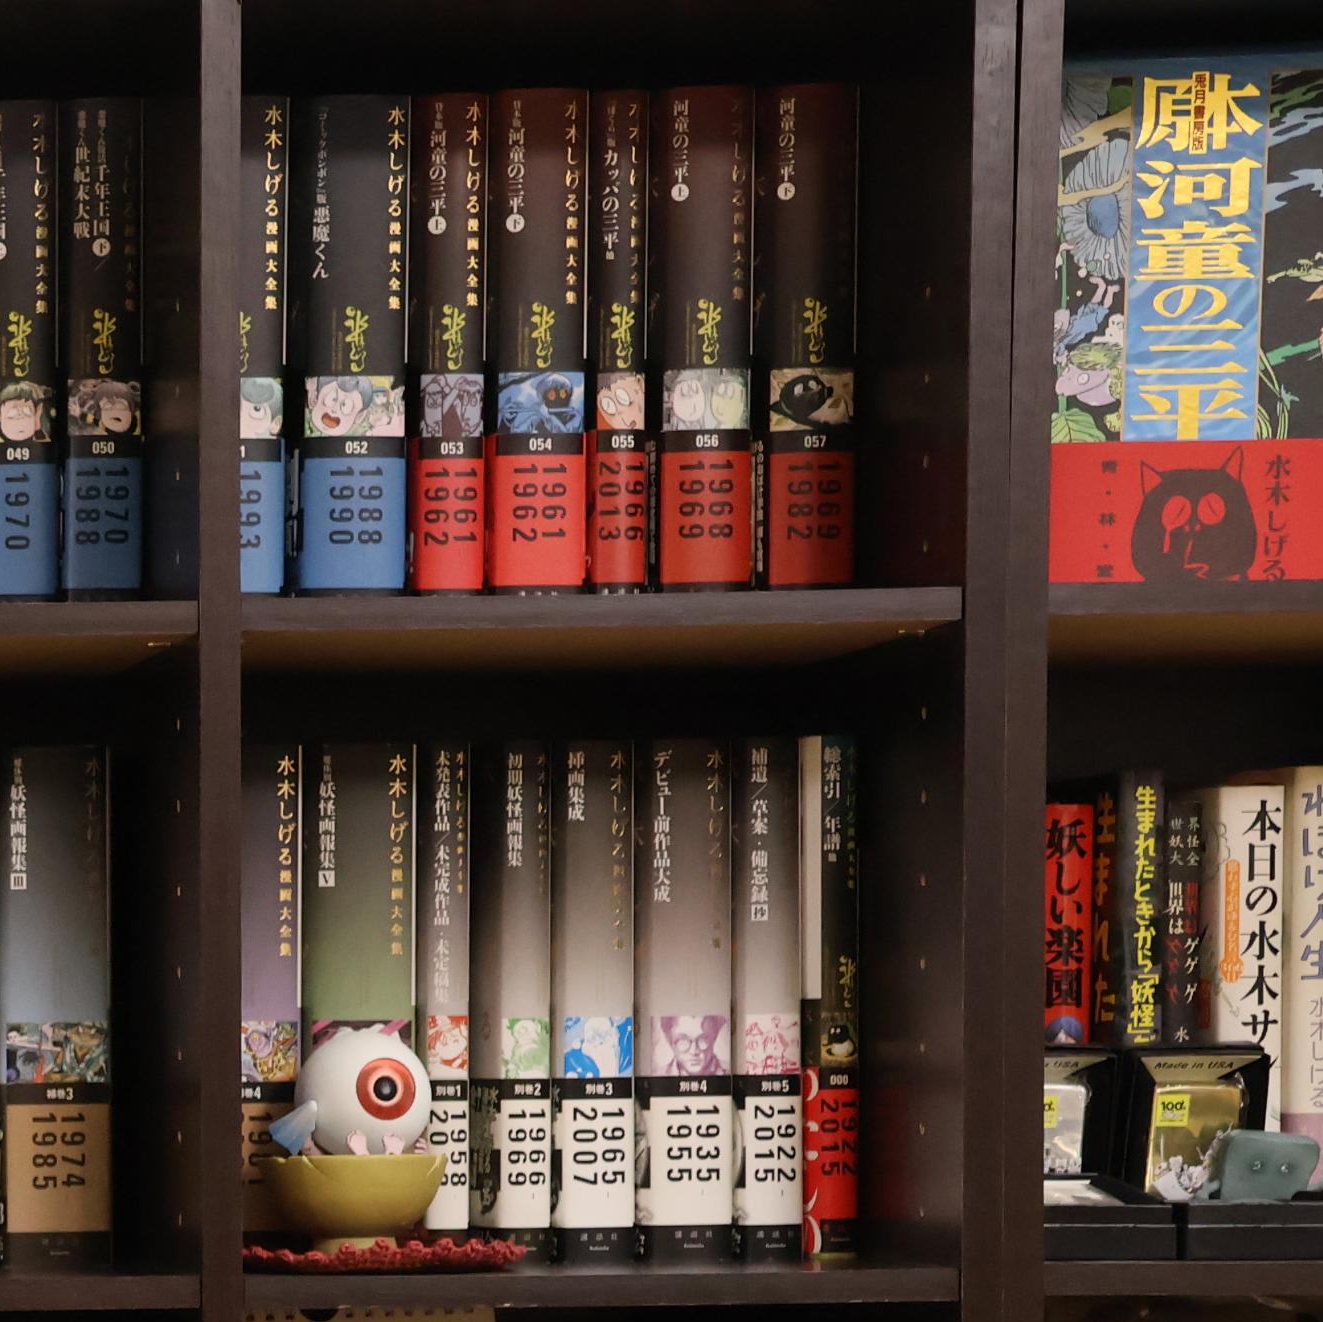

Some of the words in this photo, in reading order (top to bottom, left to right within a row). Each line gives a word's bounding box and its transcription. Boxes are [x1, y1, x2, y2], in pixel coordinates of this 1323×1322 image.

[1132, 157, 1262, 439] 河童の三平
[7, 448, 29, 461] 049
[92, 442, 114, 455] 050
[345, 441, 368, 454] 052
[441, 442, 464, 455] 053
[529, 438, 552, 450] 054
[696, 435, 718, 448] 056
[804, 436, 827, 448] 057
[5, 473, 29, 550] 1970
[359, 466, 383, 545] 1988
[513, 464, 537, 542] 1962
[542, 464, 566, 541] 1961
[679, 463, 703, 541] 1969
[1263, 453, 1291, 581] 水木しげる
[1241, 800, 1282, 1068] 本日の水木サ
[1155, 1062, 1189, 1070] Made
[1193, 1062, 1203, 1070] in
[1208, 1061, 1234, 1070] USA
[61, 1112, 85, 1190] 1974
[601, 1108, 625, 1184] 1965
[696, 1105, 720, 1181] 1935
